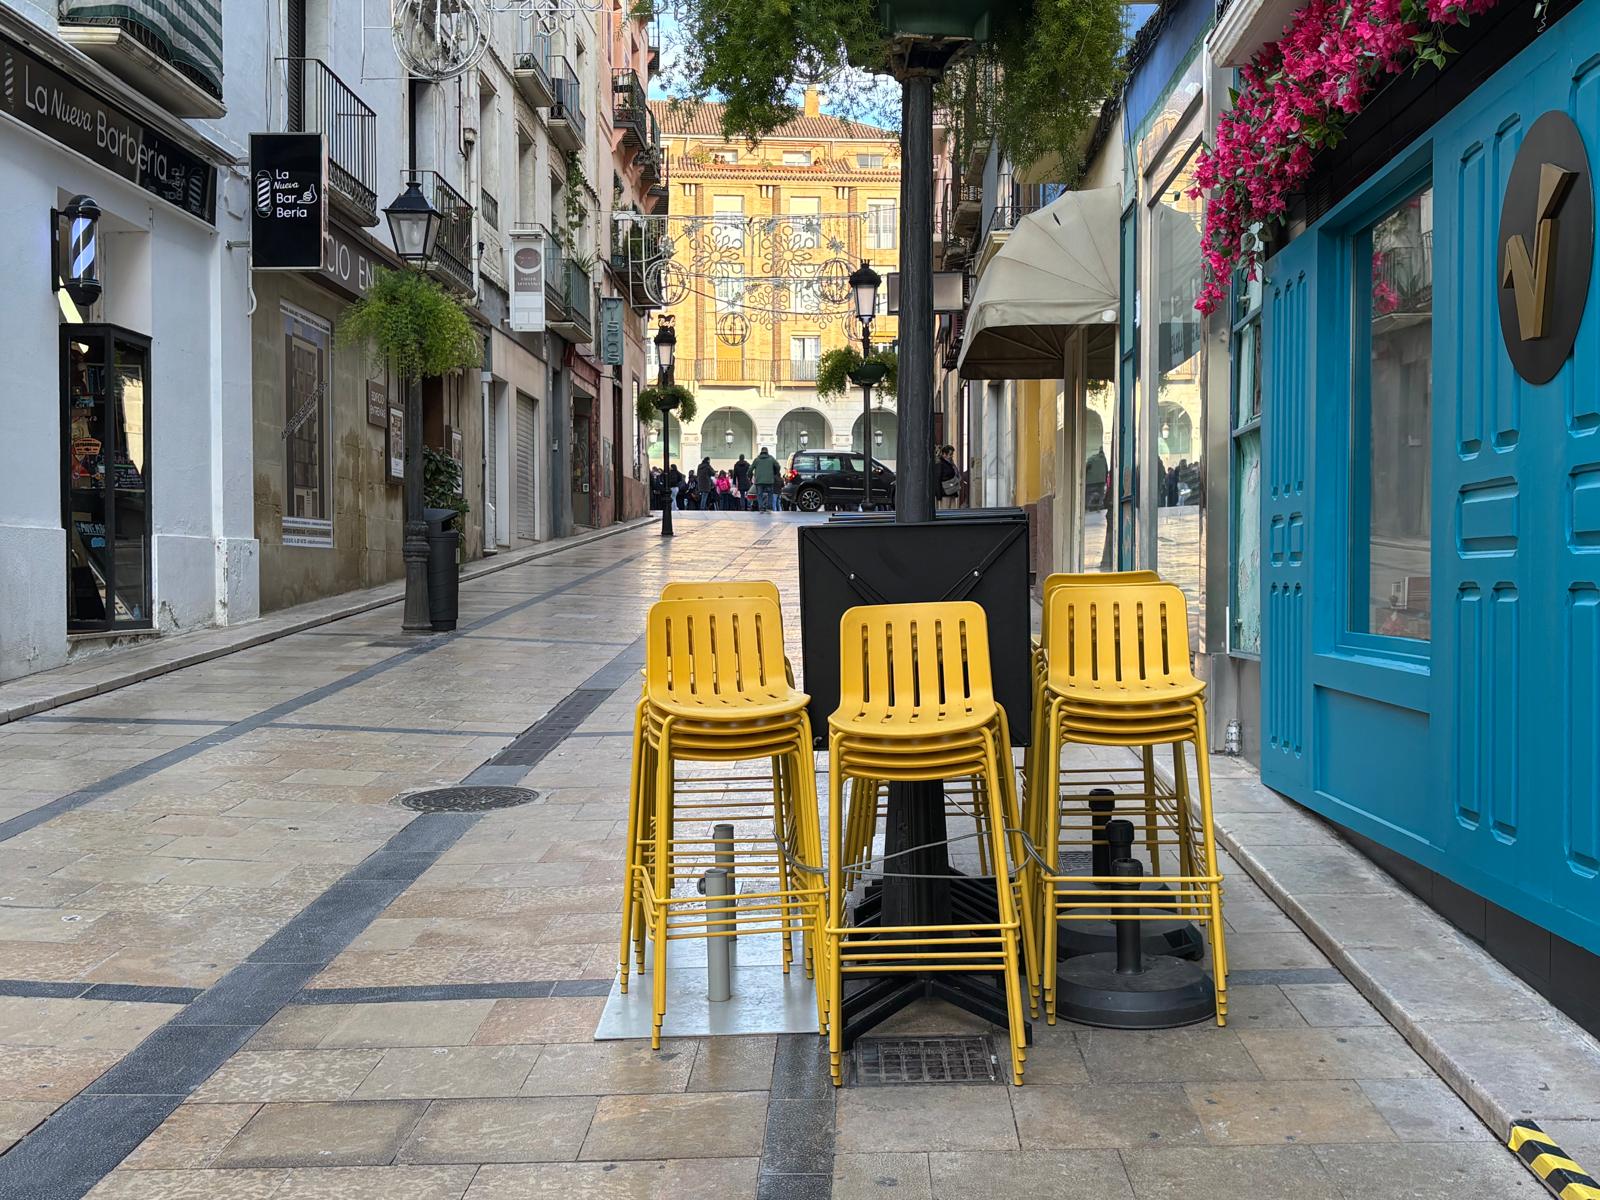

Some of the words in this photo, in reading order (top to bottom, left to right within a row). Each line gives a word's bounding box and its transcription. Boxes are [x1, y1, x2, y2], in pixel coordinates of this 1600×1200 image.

[25, 64, 48, 116] La
[50, 87, 94, 132] Nueva
[275, 168, 289, 180] La
[273, 181, 300, 190] Nueva
[276, 192, 297, 203] Bar
